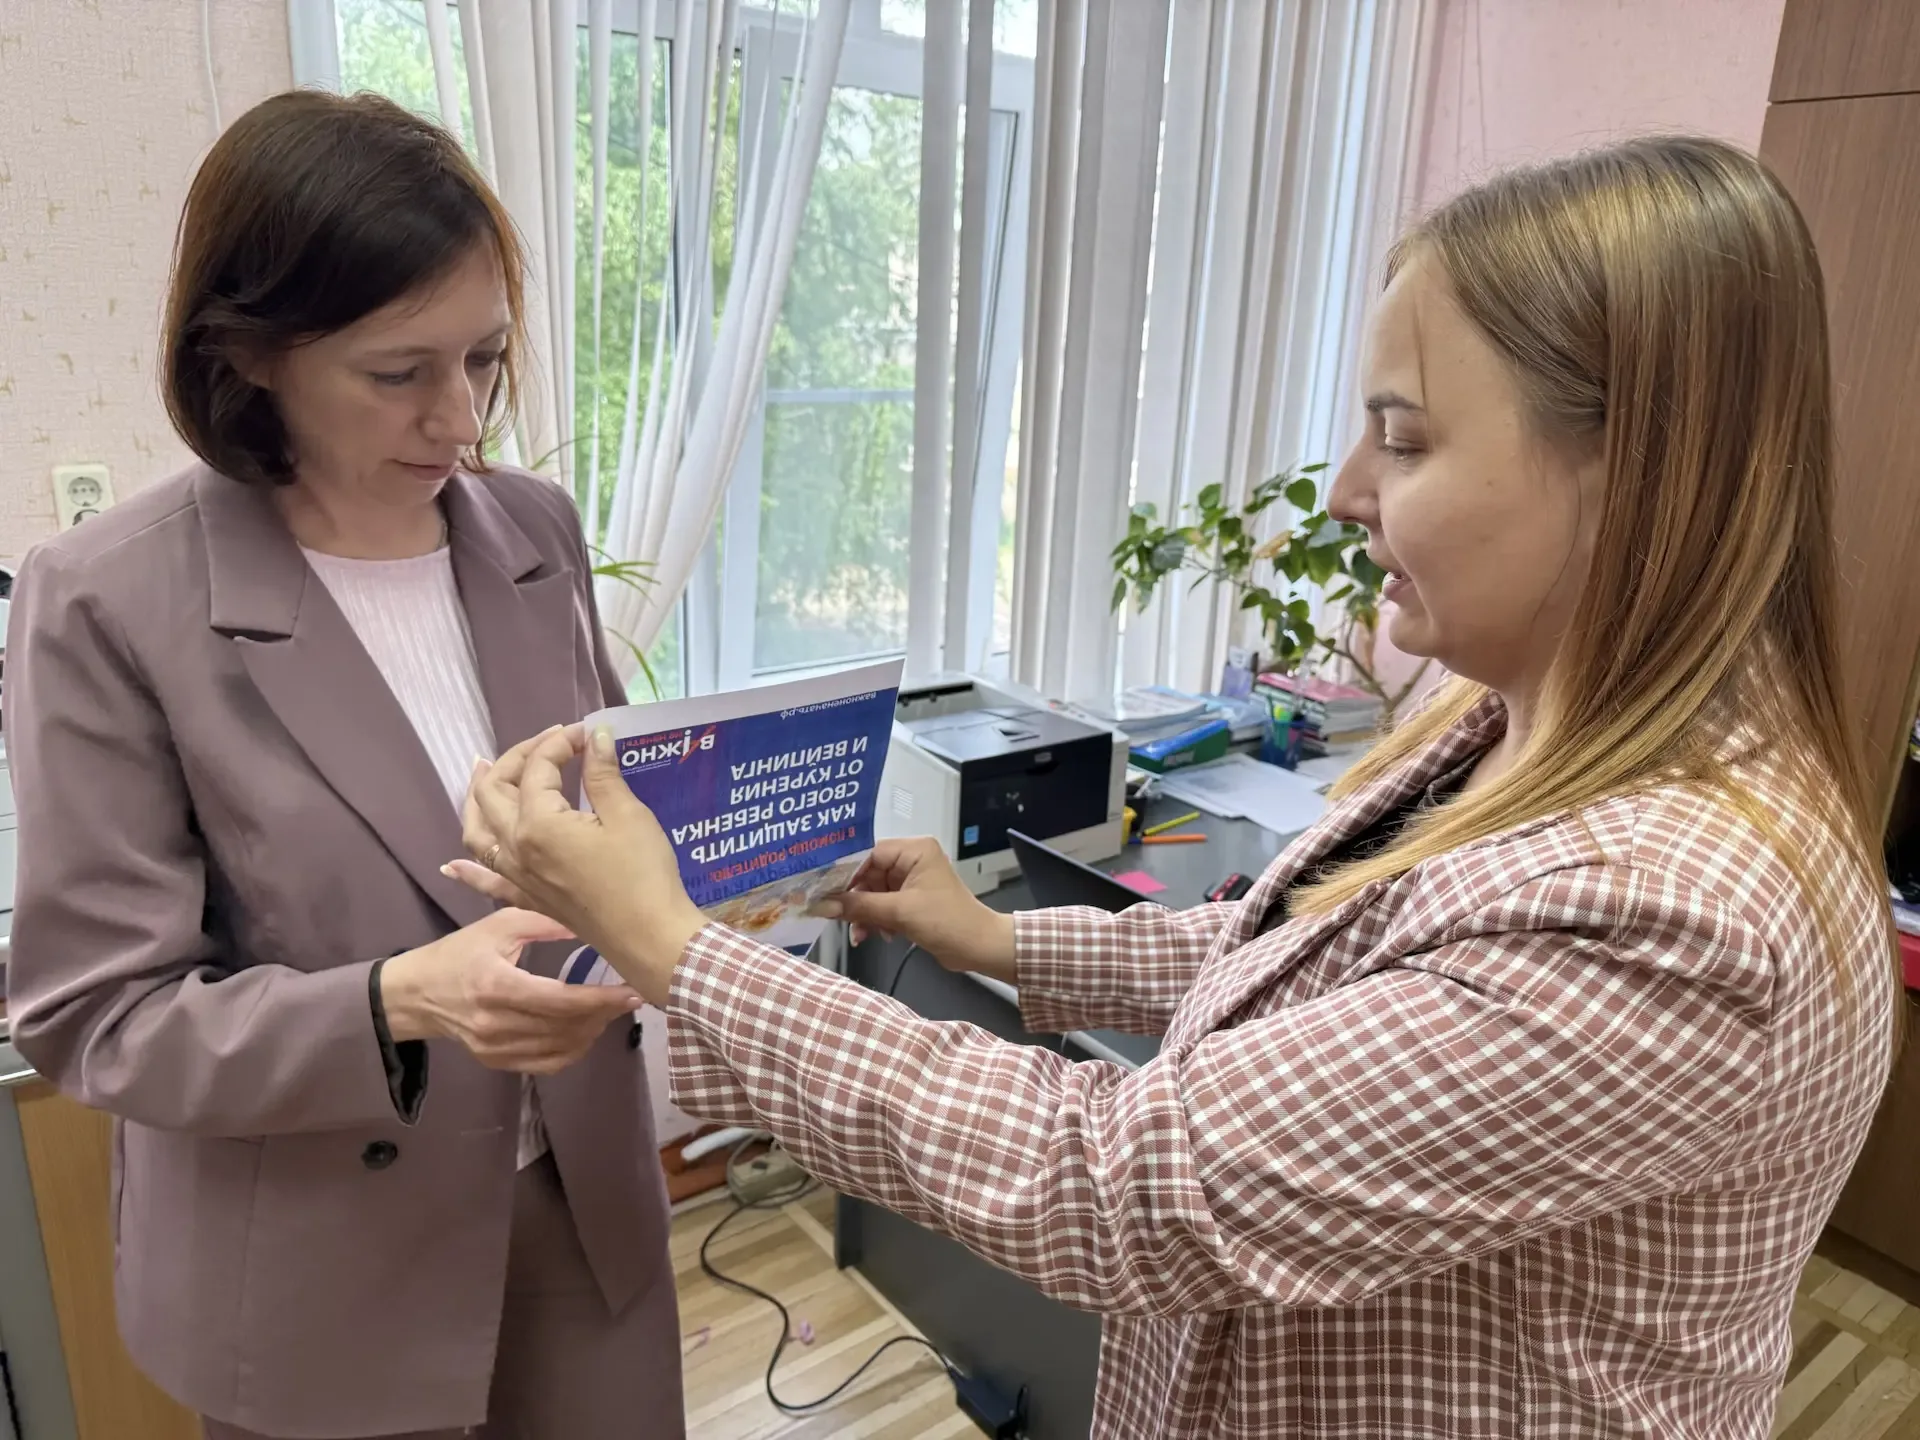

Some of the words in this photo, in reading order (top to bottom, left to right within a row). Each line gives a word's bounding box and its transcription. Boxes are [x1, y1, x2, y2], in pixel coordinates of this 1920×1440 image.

[852, 735, 868, 754] И
[730, 740, 849, 781] ВЕЙПИНГА
[835, 758, 864, 779] ОТ
[730, 765, 832, 805] КУРЕНИЯ
[778, 780, 860, 815] СВОЕГО
[671, 801, 774, 845] РЕБЕНКА
[816, 801, 857, 829] КАК
[690, 813, 813, 865] ЗАЩИТИТЬ
[788, 831, 846, 857] ПОМОЩЬ
[848, 826, 856, 838] В
